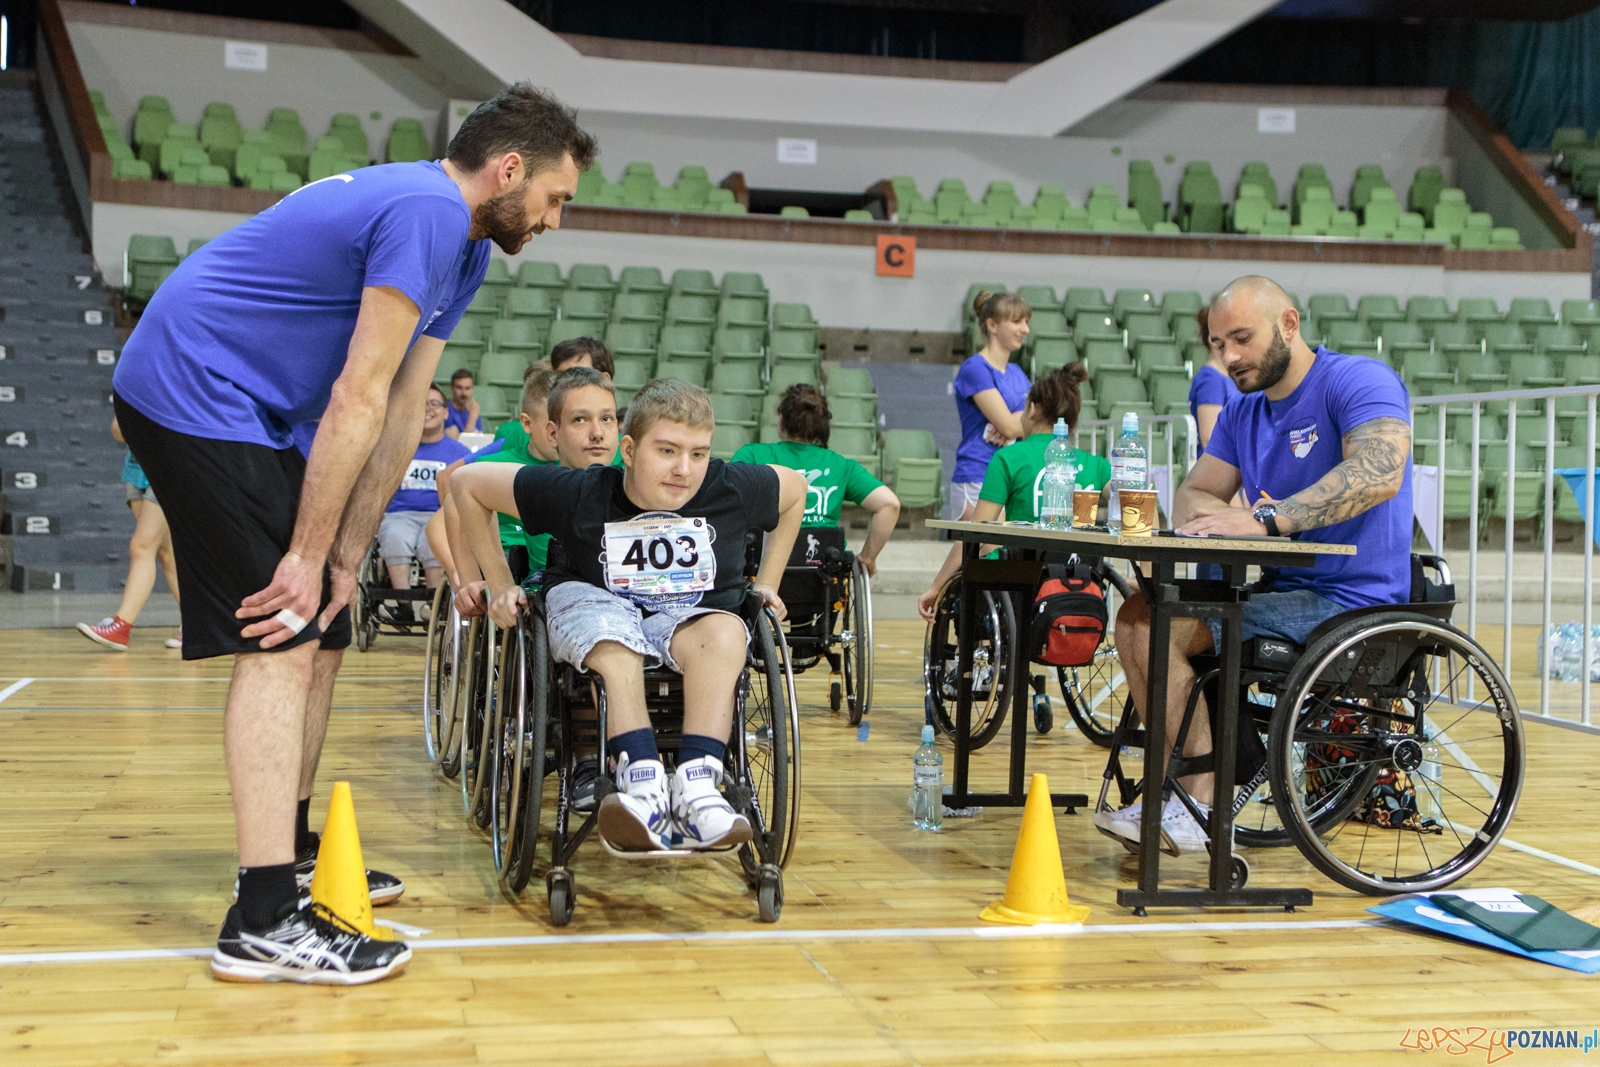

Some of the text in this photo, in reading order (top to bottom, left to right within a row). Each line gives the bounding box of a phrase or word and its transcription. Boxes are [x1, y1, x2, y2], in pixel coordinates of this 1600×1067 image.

[885, 244, 905, 267] C
[75, 276, 91, 290] 7
[85, 310, 103, 325] 6
[97, 350, 115, 365] 5
[6, 432, 28, 447] 4
[15, 473, 37, 489] 3
[409, 468, 437, 481] 401
[27, 516, 50, 534] 2
[622, 535, 699, 572] 403
[53, 572, 60, 589] 1
[1467, 654, 1513, 731] SPINERY
[631, 768, 655, 781] PIEDRO
[687, 767, 712, 780] PIEDRO
